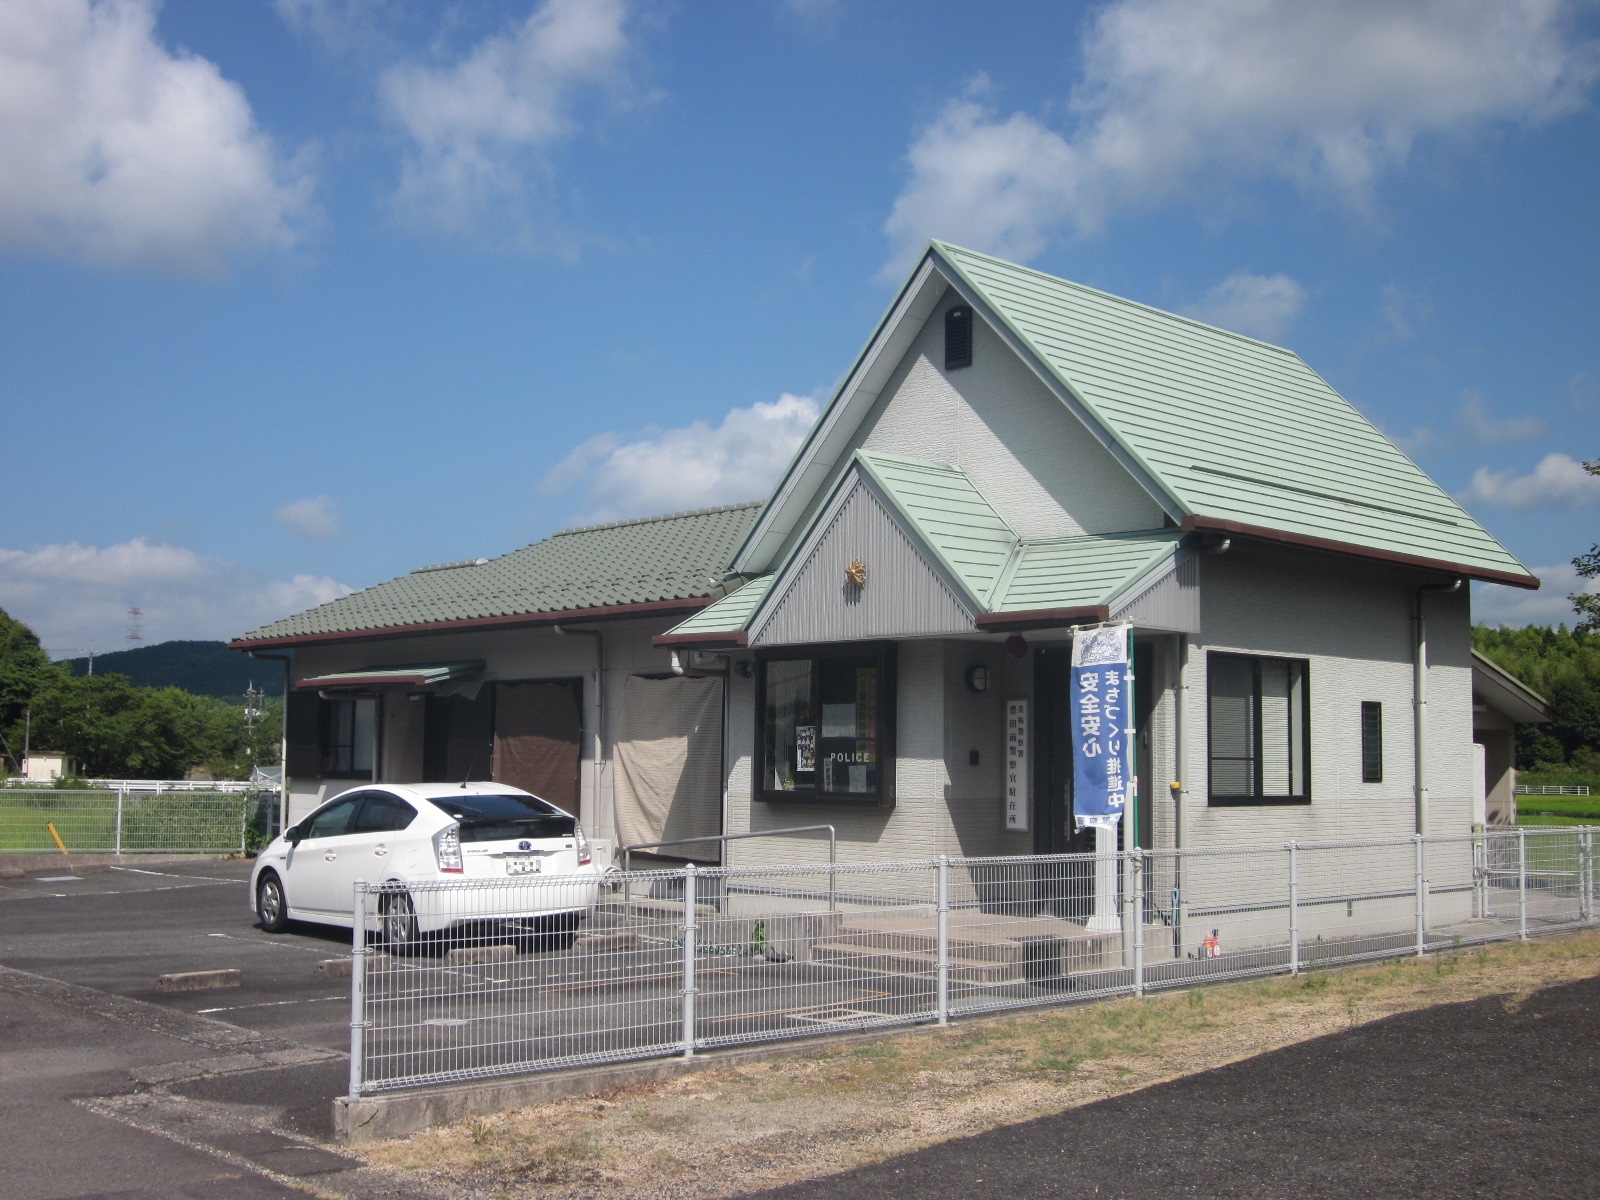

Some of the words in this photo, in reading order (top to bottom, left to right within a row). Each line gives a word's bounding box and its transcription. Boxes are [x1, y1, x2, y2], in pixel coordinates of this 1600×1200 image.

[830, 752, 870, 763] POLICE
[1009, 705, 1017, 825] 豊田前警察官駐在所
